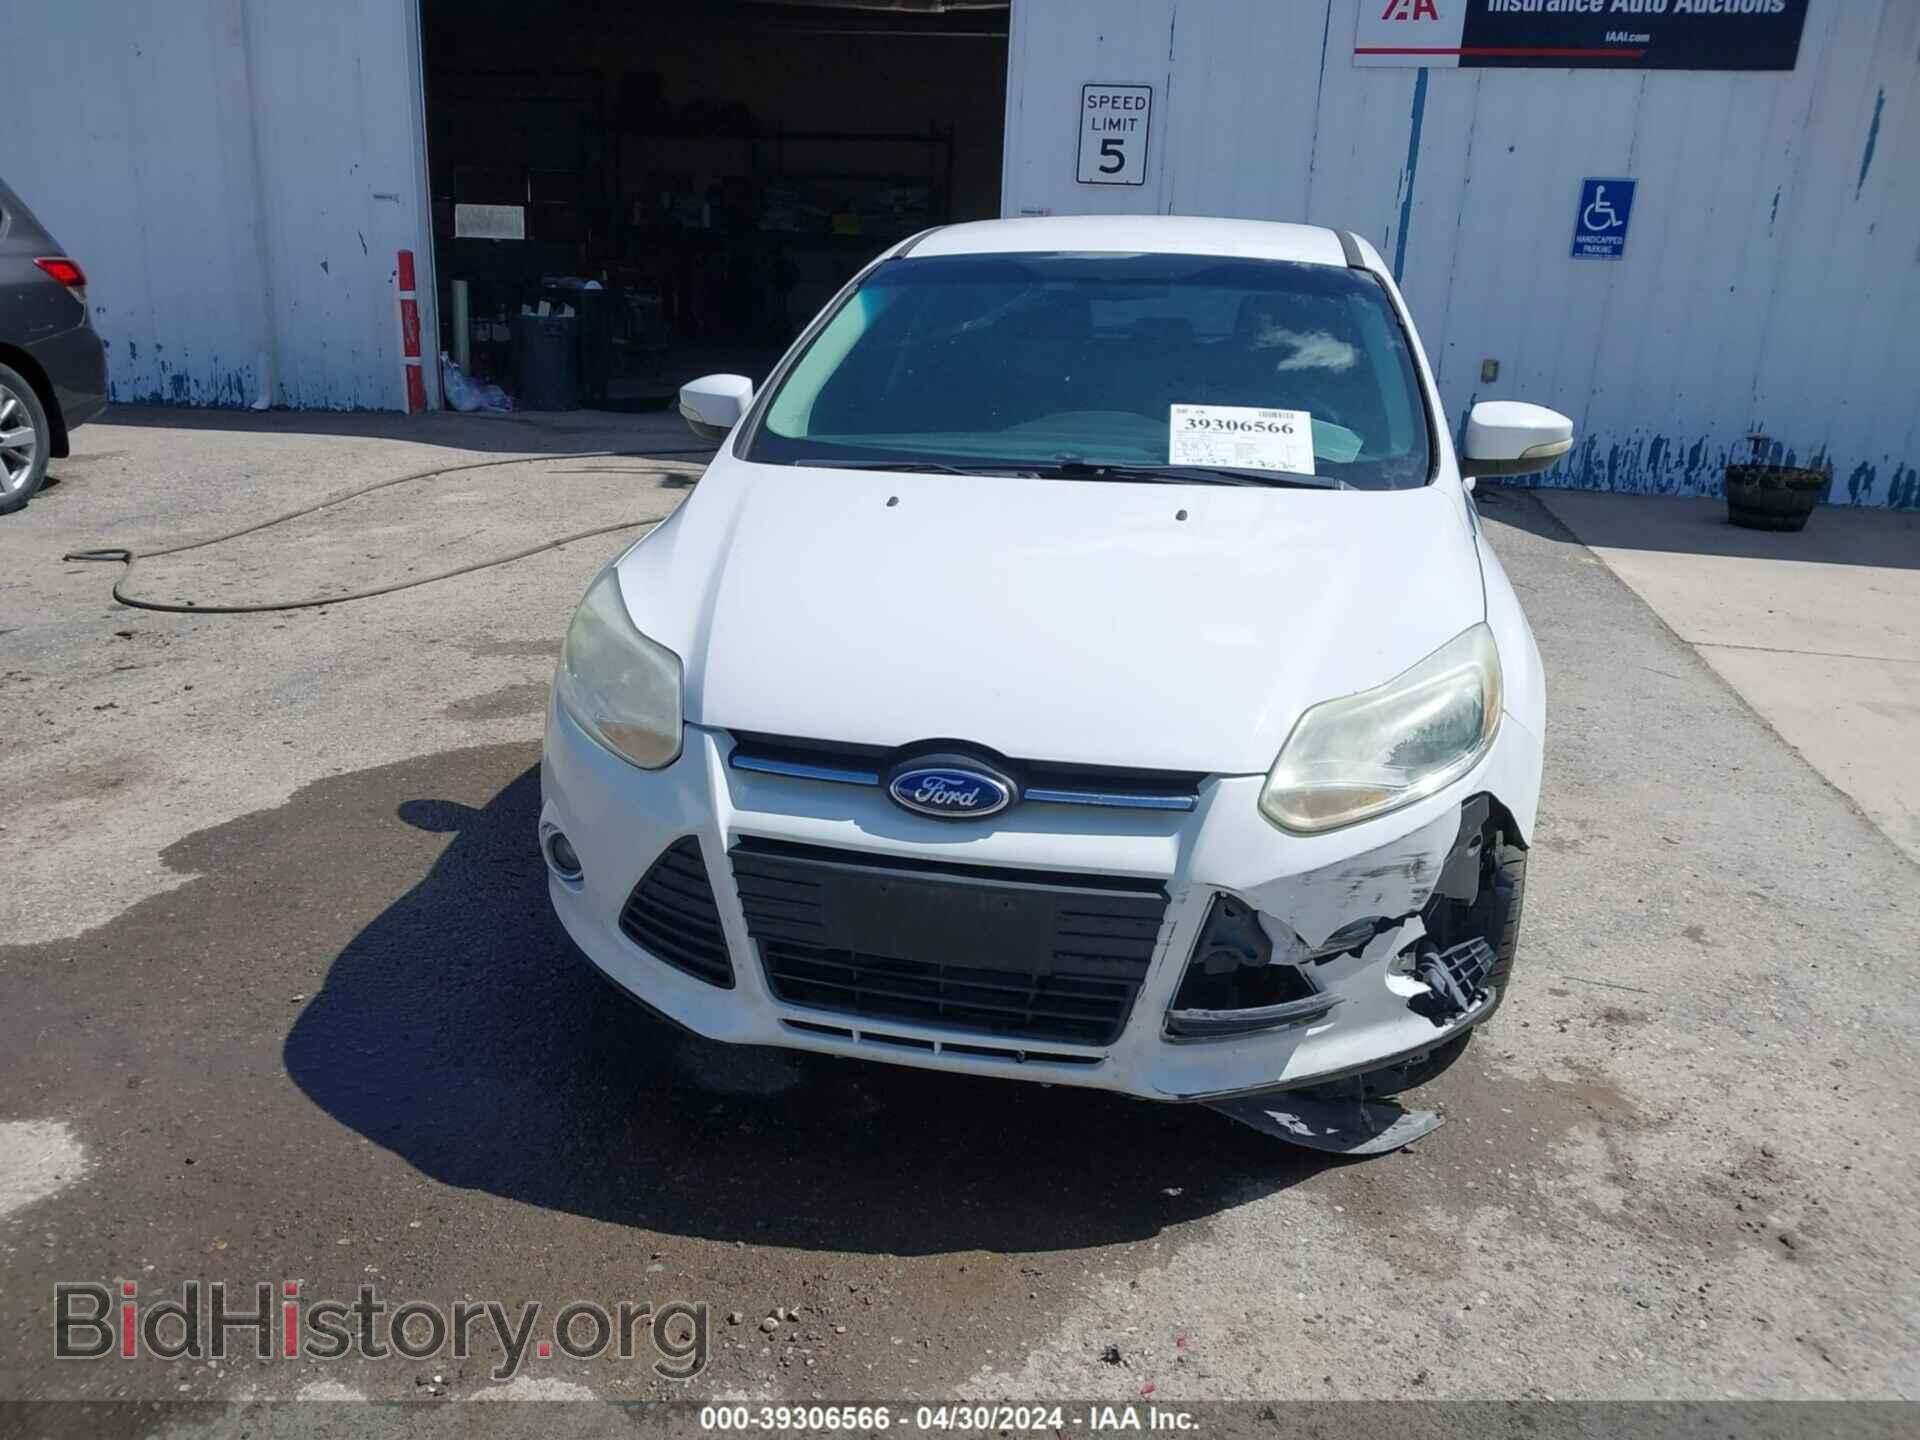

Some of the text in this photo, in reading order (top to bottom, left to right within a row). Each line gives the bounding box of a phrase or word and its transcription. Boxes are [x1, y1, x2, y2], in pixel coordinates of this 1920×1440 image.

[1605, 31, 1650, 43] IAAI.com
[1087, 95, 1146, 110] SPEED
[1091, 117, 1138, 132] LIMIT
[1098, 138, 1126, 174] 5
[1576, 235, 1623, 244] HANDICAPPED
[1583, 245, 1613, 254] PARKING
[1183, 418, 1295, 435] 39306566
[914, 776, 980, 806] Ford
